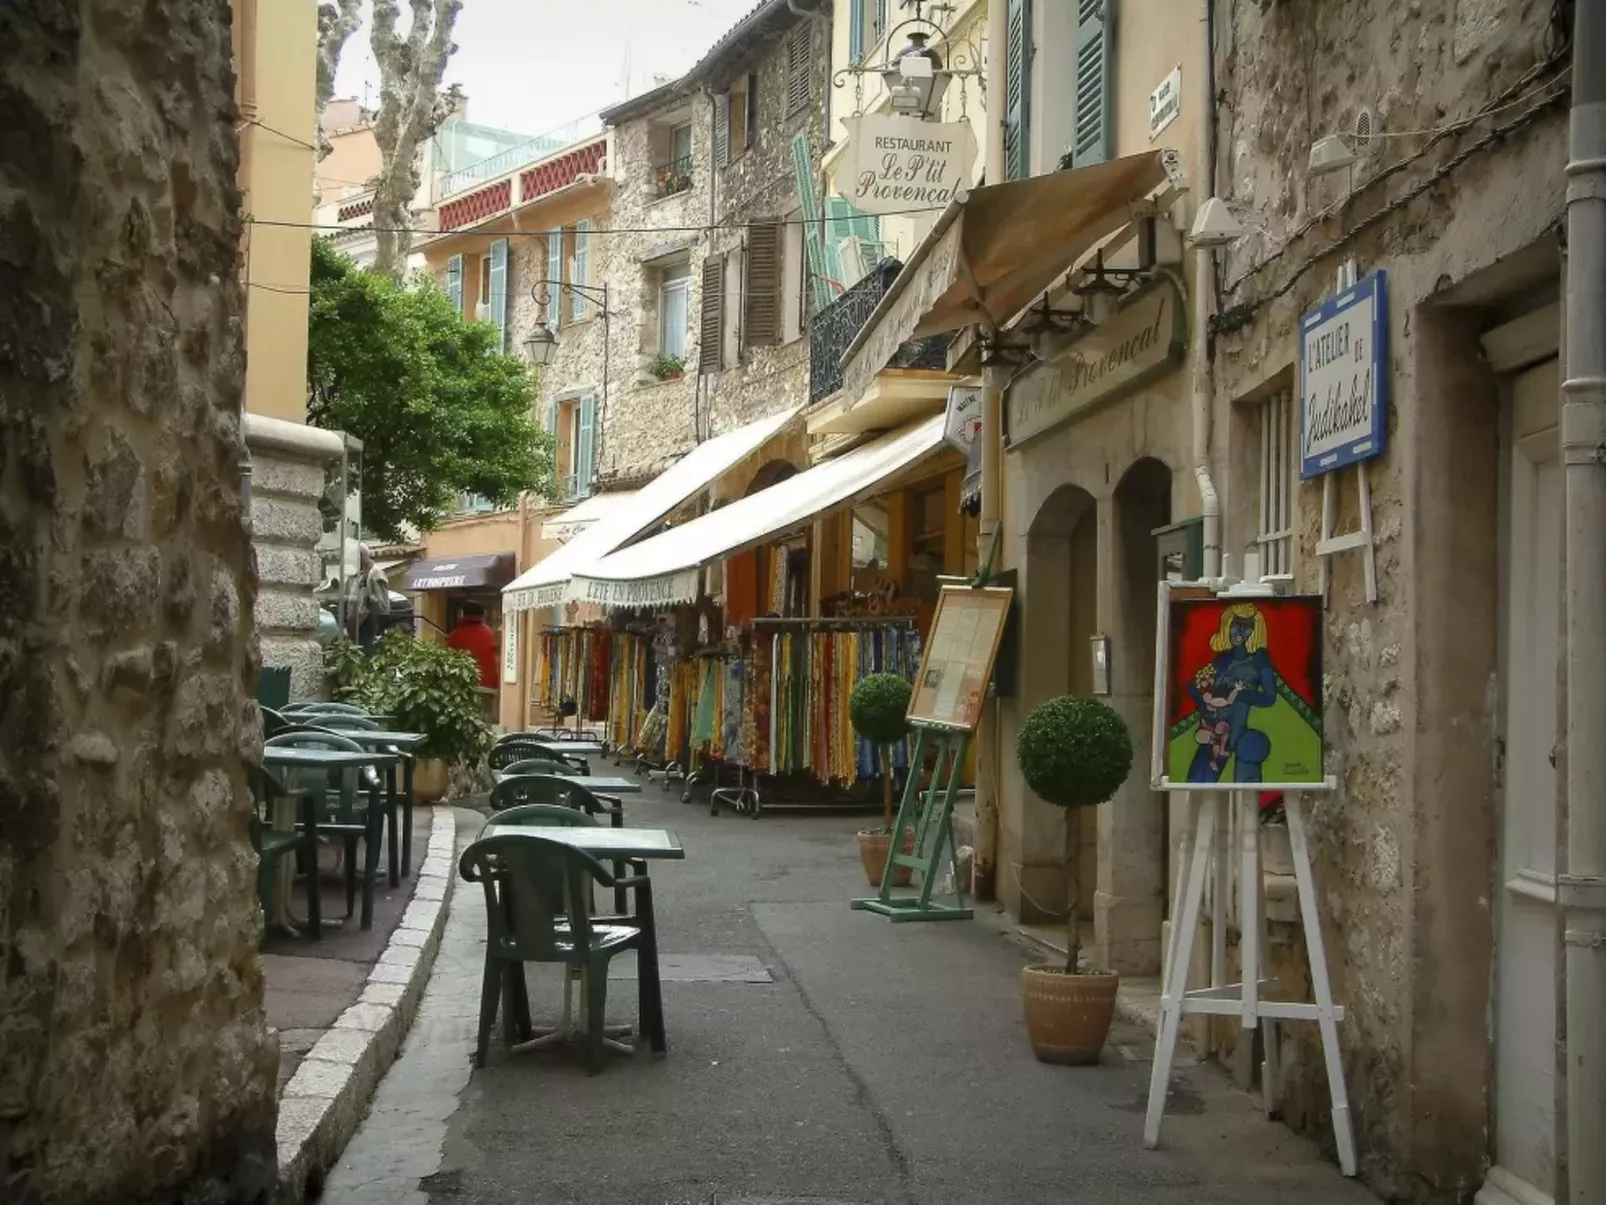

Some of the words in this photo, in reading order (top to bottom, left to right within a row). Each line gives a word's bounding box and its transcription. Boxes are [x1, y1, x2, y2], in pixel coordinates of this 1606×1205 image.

[874, 136, 952, 153] RESTAURANT
[879, 153, 903, 181] Le
[904, 154, 948, 183] P'tit
[855, 170, 961, 206] Provençal
[1308, 322, 1350, 373] L'ATELIER
[1354, 338, 1364, 363] DE
